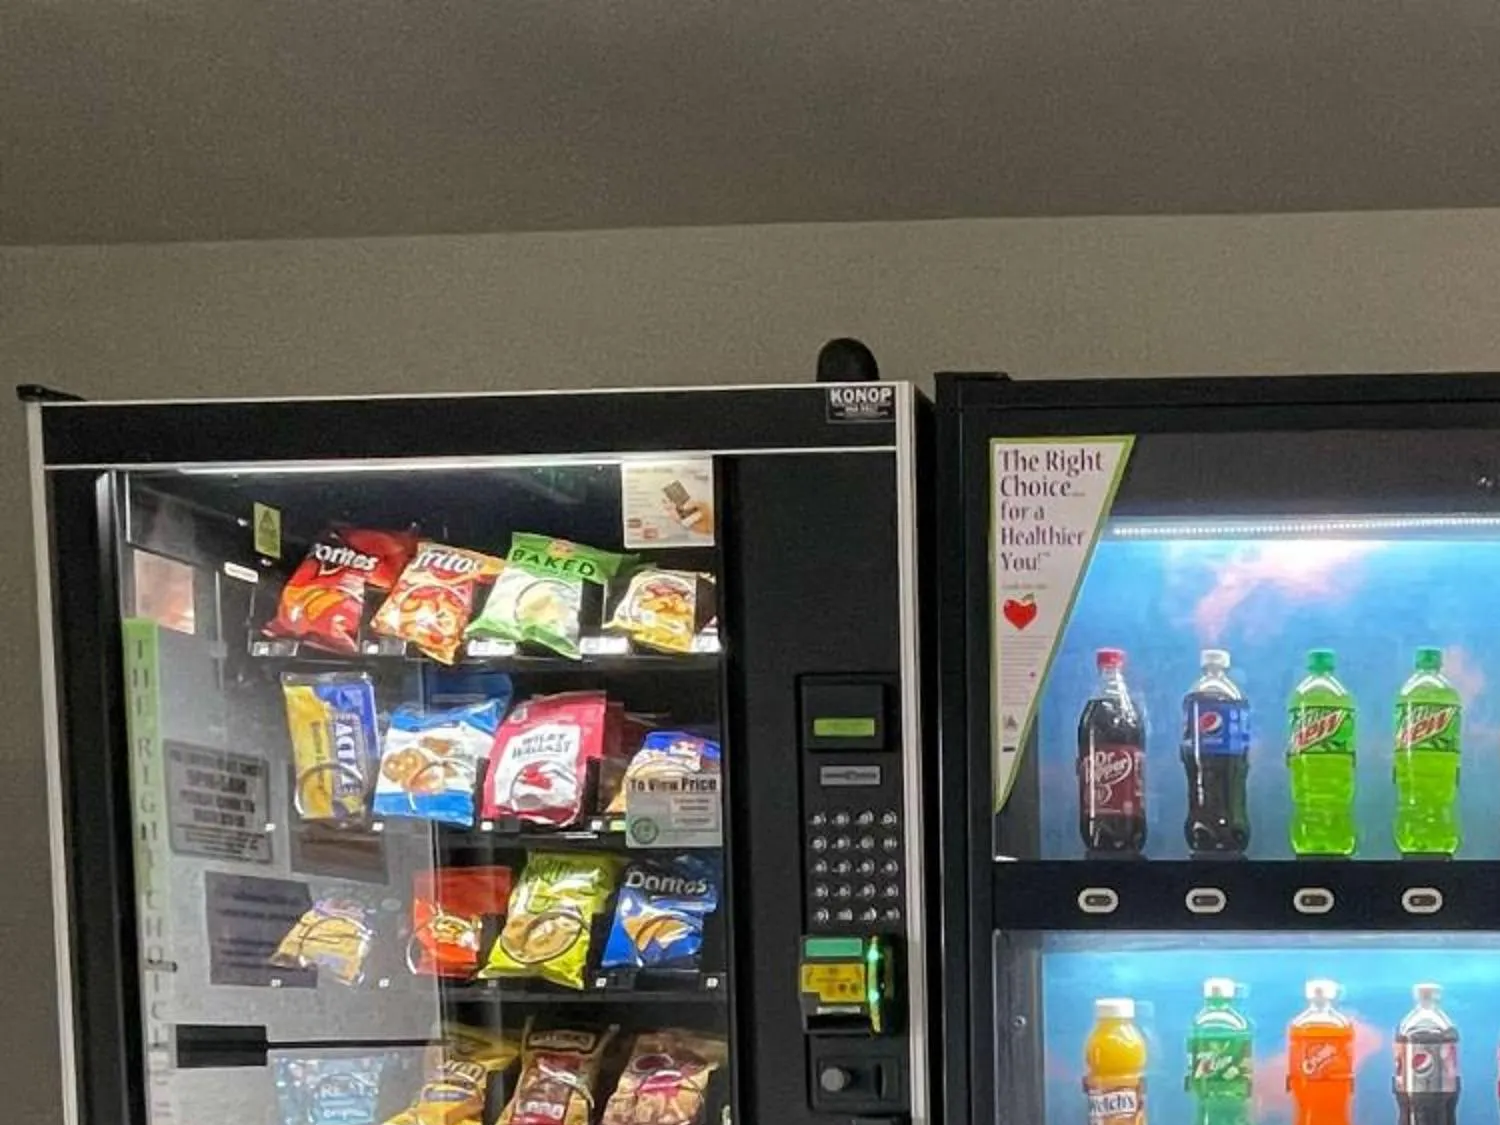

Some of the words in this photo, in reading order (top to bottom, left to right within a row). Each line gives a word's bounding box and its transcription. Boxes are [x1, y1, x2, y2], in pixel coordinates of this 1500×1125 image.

[830, 387, 893, 404] KONOP
[1000, 449, 1039, 472] The
[1046, 448, 1104, 477] Right
[1001, 499, 1030, 521] for
[1033, 505, 1045, 521] a
[1001, 525, 1084, 546] Healthier
[512, 549, 595, 578] BAKED
[681, 777, 717, 792] Price
[626, 870, 708, 894] Doritos
